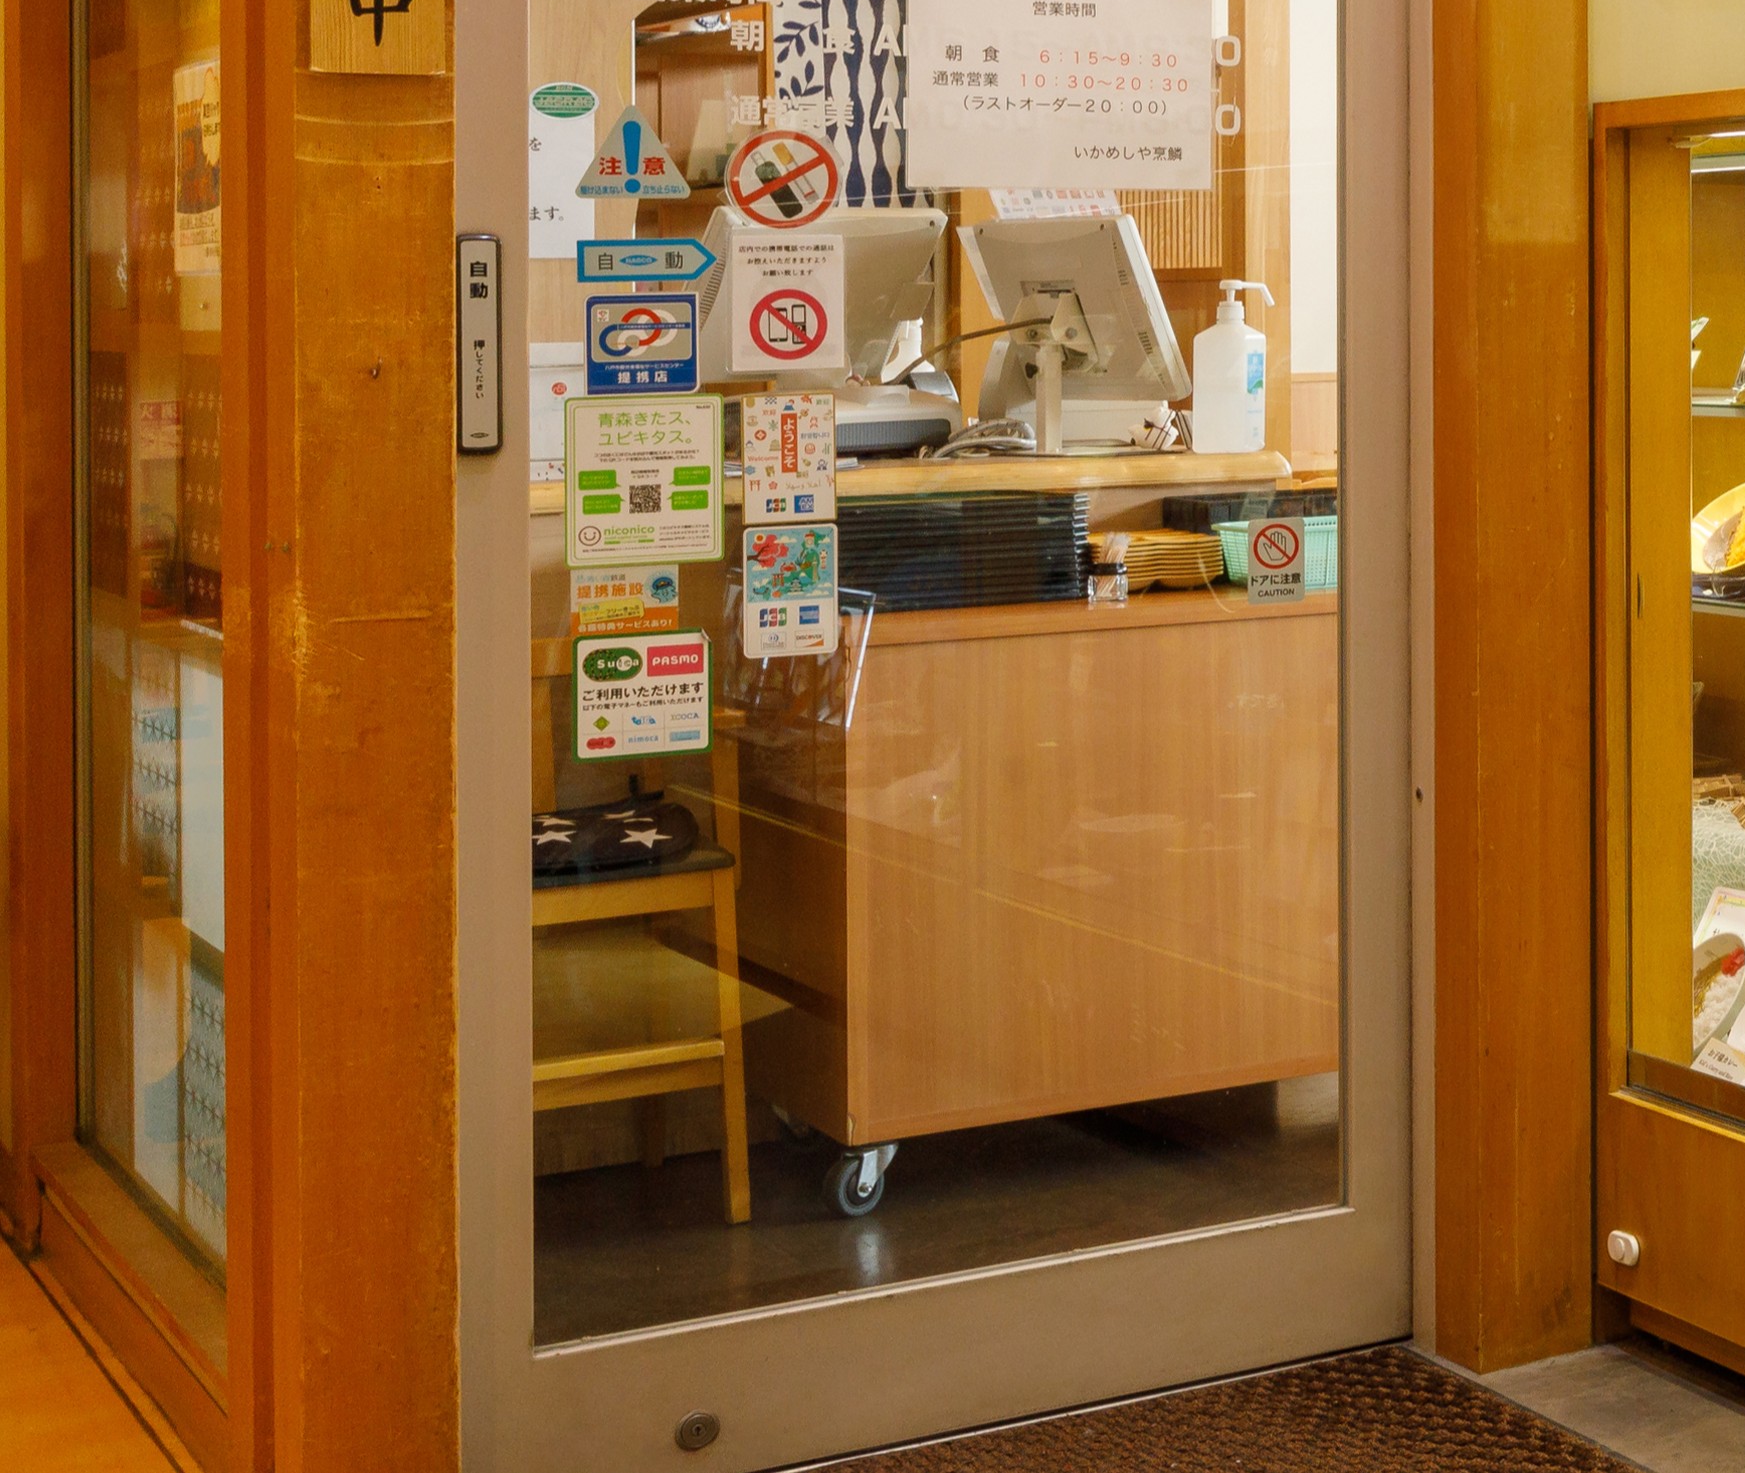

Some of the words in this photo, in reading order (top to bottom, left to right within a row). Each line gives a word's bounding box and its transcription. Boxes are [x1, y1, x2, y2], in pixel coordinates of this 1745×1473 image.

[1032, 0, 1098, 19] 営業時間
[931, 69, 1000, 89] 通常営業
[1074, 144, 1184, 164] いかめしや烹鱗
[469, 261, 489, 299] 自動
[473, 339, 486, 400] 押してください
[616, 370, 668, 384] 提携店
[782, 417, 796, 469] ようこそ
[603, 524, 655, 536] niconico
[576, 582, 645, 600] 提携施設
[1250, 573, 1302, 590] ドアに注意
[1257, 587, 1296, 599] CAUTION
[596, 656, 640, 671] Suica
[652, 653, 699, 667] PASMO
[582, 681, 705, 702] ご利用いただけます
